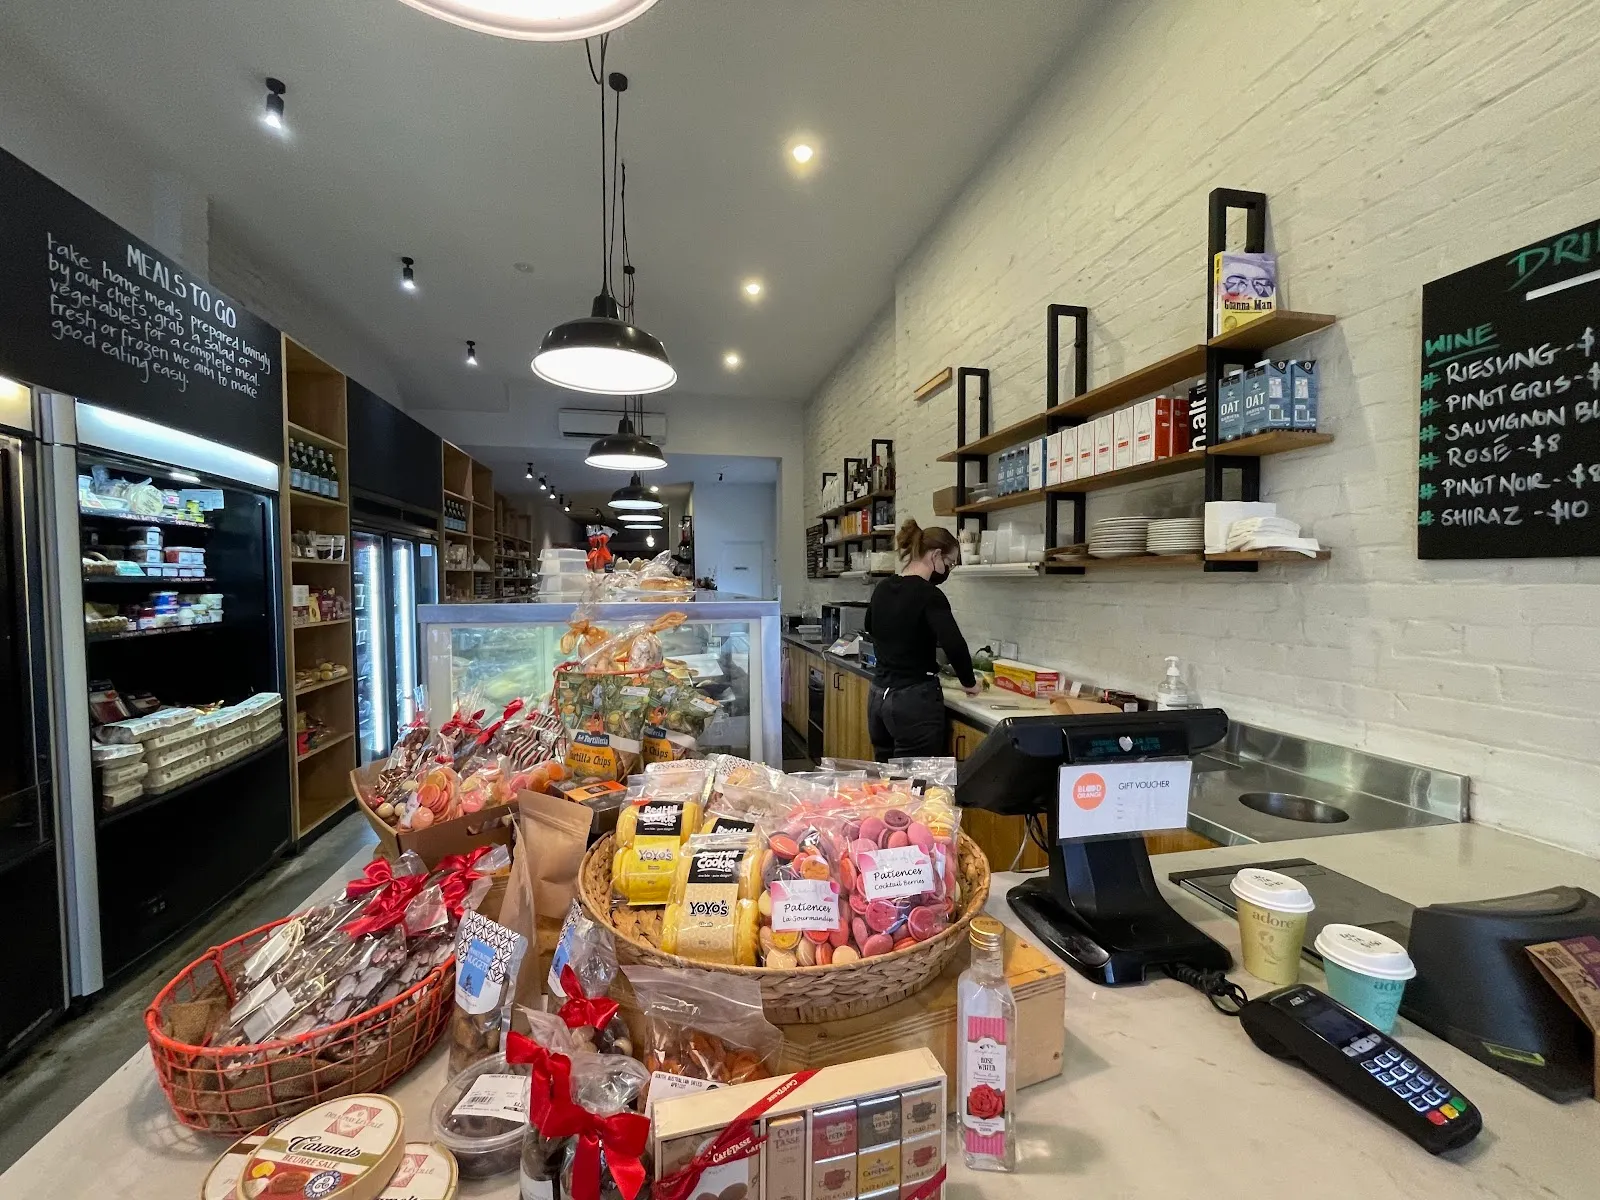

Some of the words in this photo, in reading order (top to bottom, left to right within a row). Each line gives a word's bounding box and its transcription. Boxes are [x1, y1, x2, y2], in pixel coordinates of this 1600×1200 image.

[1506, 228, 1600, 291] DRI
[127, 245, 186, 298] MEALS
[190, 282, 210, 312] TO
[215, 300, 236, 328] GO
[49, 253, 70, 284] by
[75, 270, 103, 292] our
[155, 312, 184, 336] grab
[192, 334, 200, 344] a
[205, 338, 234, 366] salad
[239, 357, 252, 368] or
[1254, 299, 1272, 310] Man
[50, 278, 141, 330] vegetables
[145, 323, 165, 347] for
[171, 338, 180, 348] a
[183, 341, 232, 373] complete
[103, 261, 140, 296] home
[145, 291, 182, 320] meals
[191, 315, 238, 350] prepared
[243, 341, 271, 374] lovingly
[50, 295, 96, 330] fresh
[101, 324, 118, 338] or
[121, 331, 168, 361] frozen
[173, 354, 189, 369] we
[194, 359, 214, 379] aim
[218, 372, 227, 387] to
[231, 378, 257, 399] make
[1425, 323, 1497, 358] WINE
[52, 320, 96, 348] good
[102, 342, 149, 384] eating
[1245, 392, 1265, 409] OAT
[1446, 384, 1507, 412] PINOT
[1510, 375, 1571, 401] GRIS
[1221, 400, 1240, 416] OAT
[1445, 406, 1565, 441] SAUVIGNON
[1447, 434, 1512, 468] ROSÉ
[1441, 475, 1496, 497] PINOT
[1500, 472, 1552, 496] NOIR
[1441, 506, 1522, 526] SHIRAZ
[593, 755, 611, 768] Chips
[649, 746, 669, 758] Chips
[1118, 781, 1133, 790] GIFT
[1135, 780, 1170, 790] VOUCHER
[697, 857, 735, 869] Cookie
[873, 868, 922, 881] Patiences
[875, 880, 902, 890] Cocktail
[690, 899, 729, 916] YoYo's
[784, 902, 831, 913] Patiences
[1252, 910, 1294, 929] adore
[288, 1135, 361, 1158] Caramels
[282, 1154, 316, 1167] BEURRE
